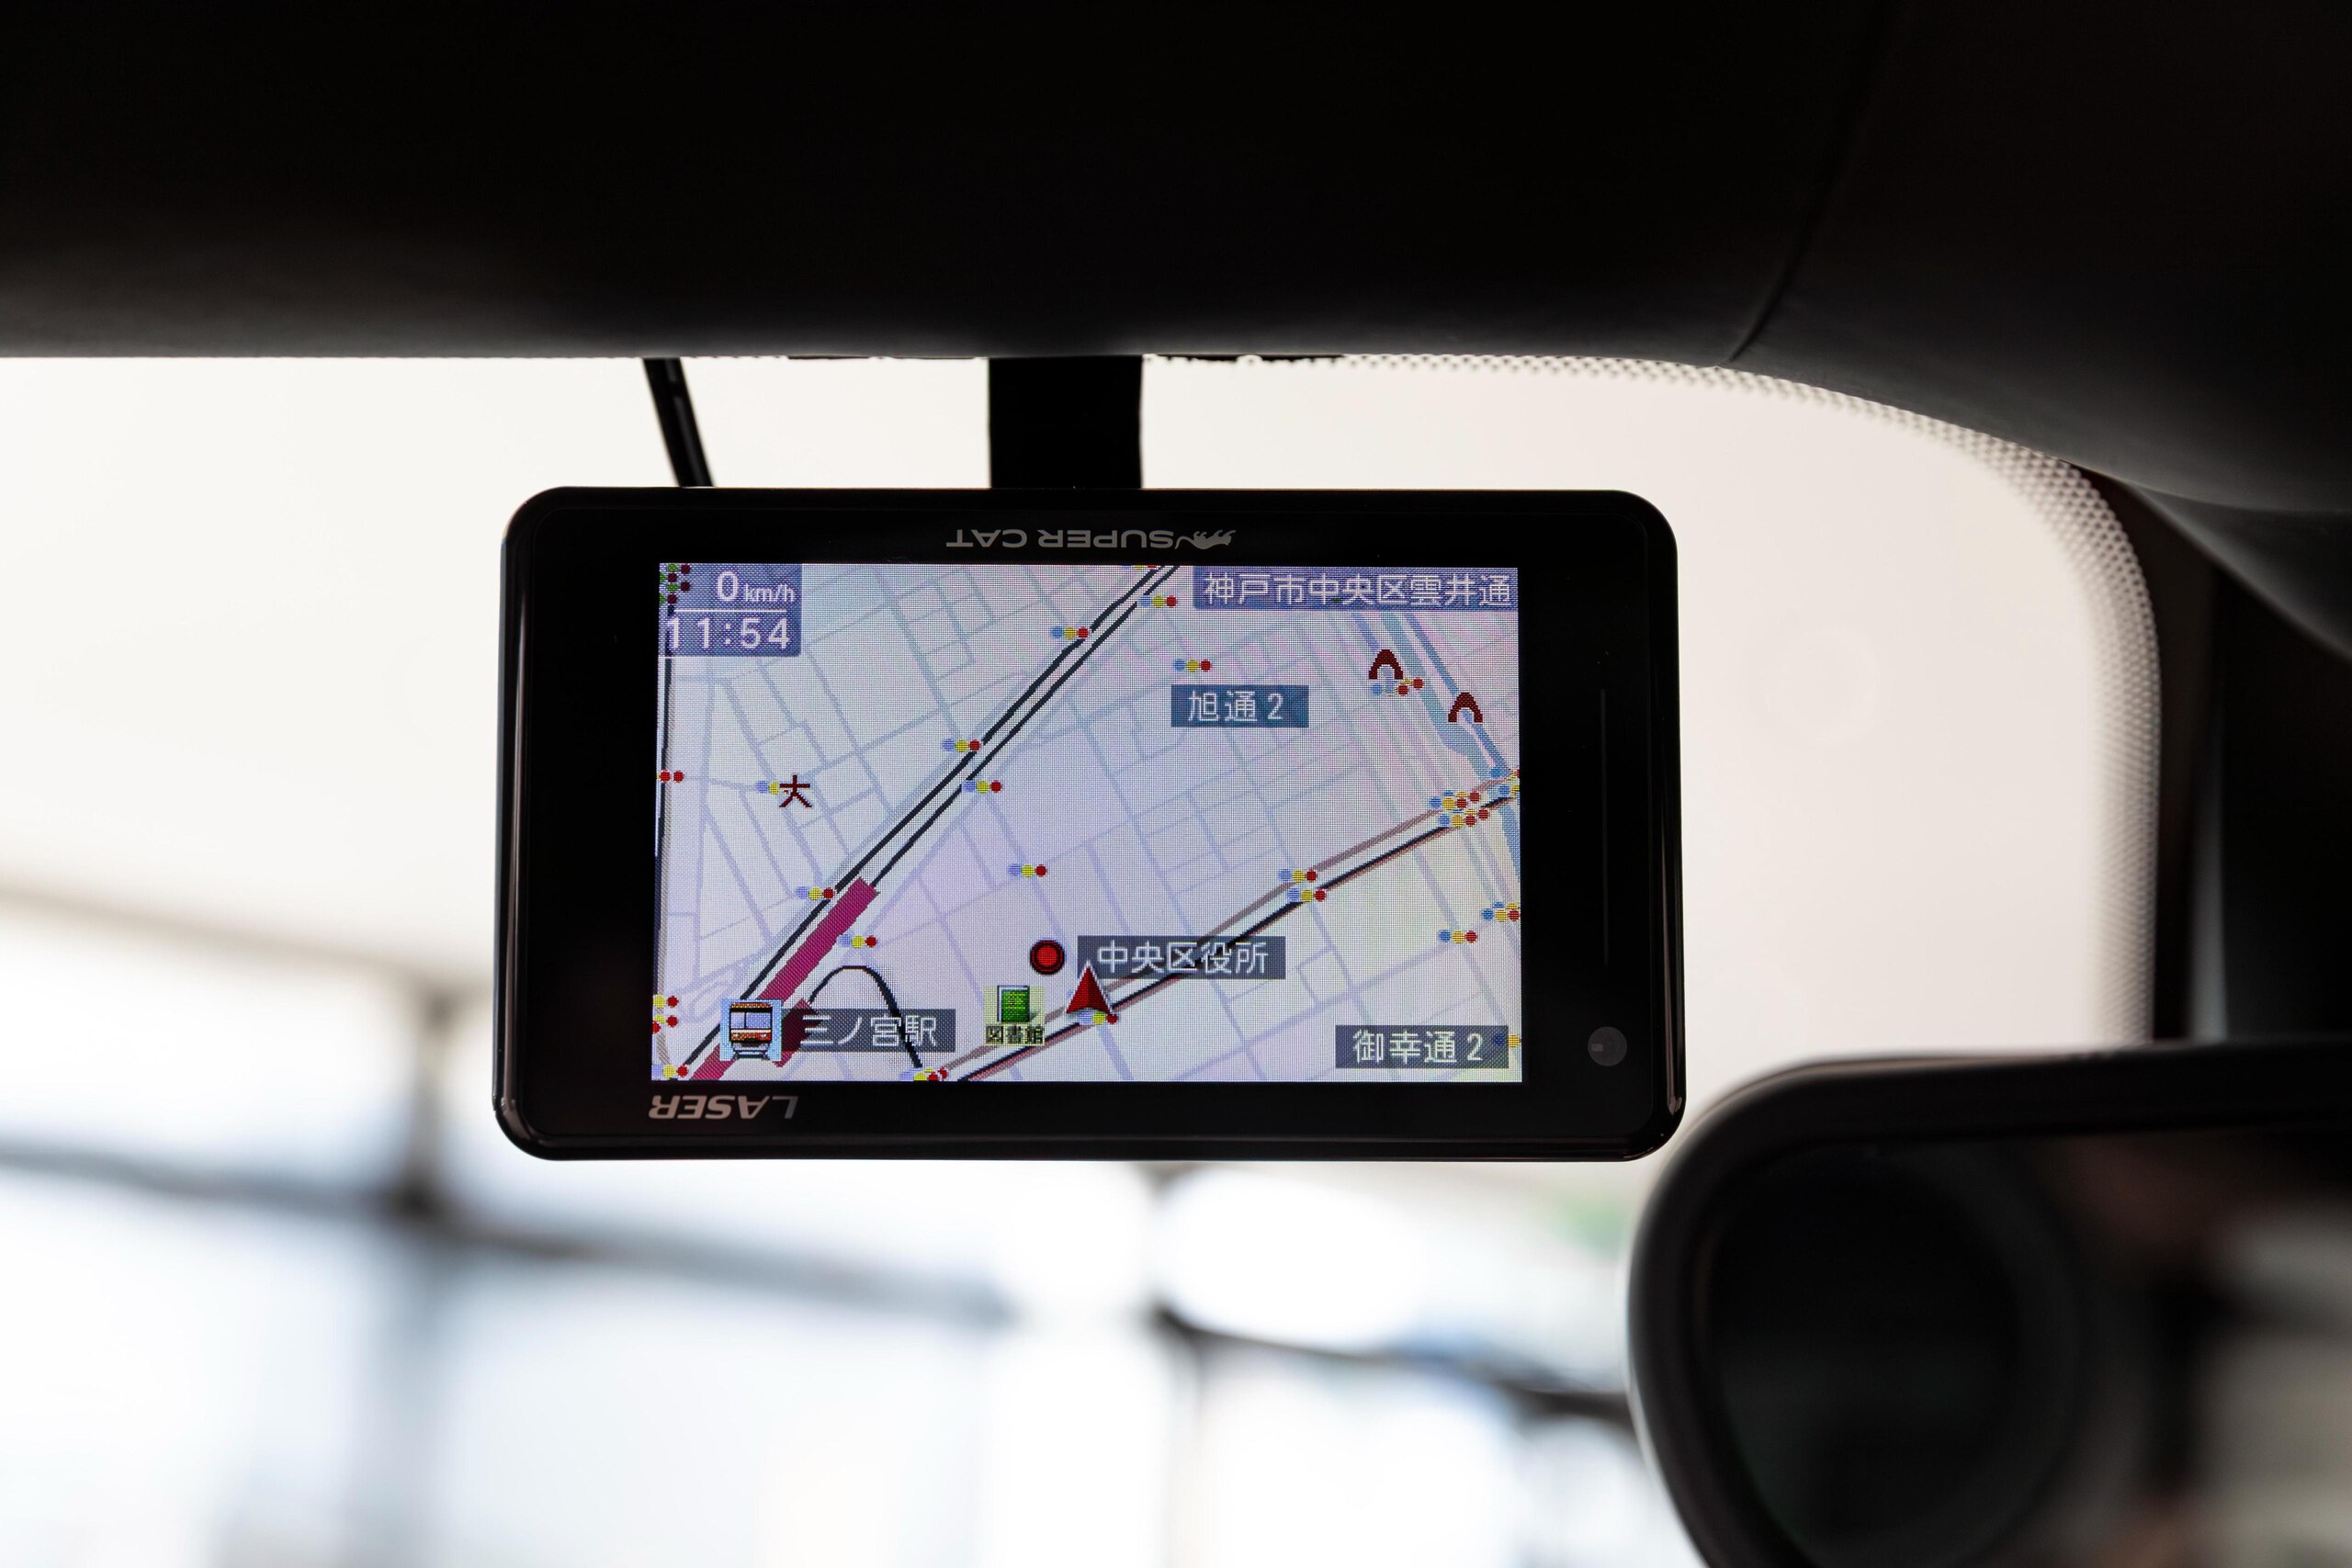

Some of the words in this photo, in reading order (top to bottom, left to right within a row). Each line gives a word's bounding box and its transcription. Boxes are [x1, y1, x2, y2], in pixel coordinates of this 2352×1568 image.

[946, 529, 1027, 548] CAT
[1038, 529, 1174, 548] SUPER
[717, 570, 740, 602] 0
[745, 583, 795, 603] km/h
[1204, 572, 1512, 606] 神戸市中央区雲井通
[666, 616, 792, 649] 11:54
[1096, 939, 1269, 975] 中央区役所
[802, 1013, 938, 1047] 三ノ宮駅
[985, 1024, 1044, 1045] 図書館
[648, 1094, 799, 1120] LASER
